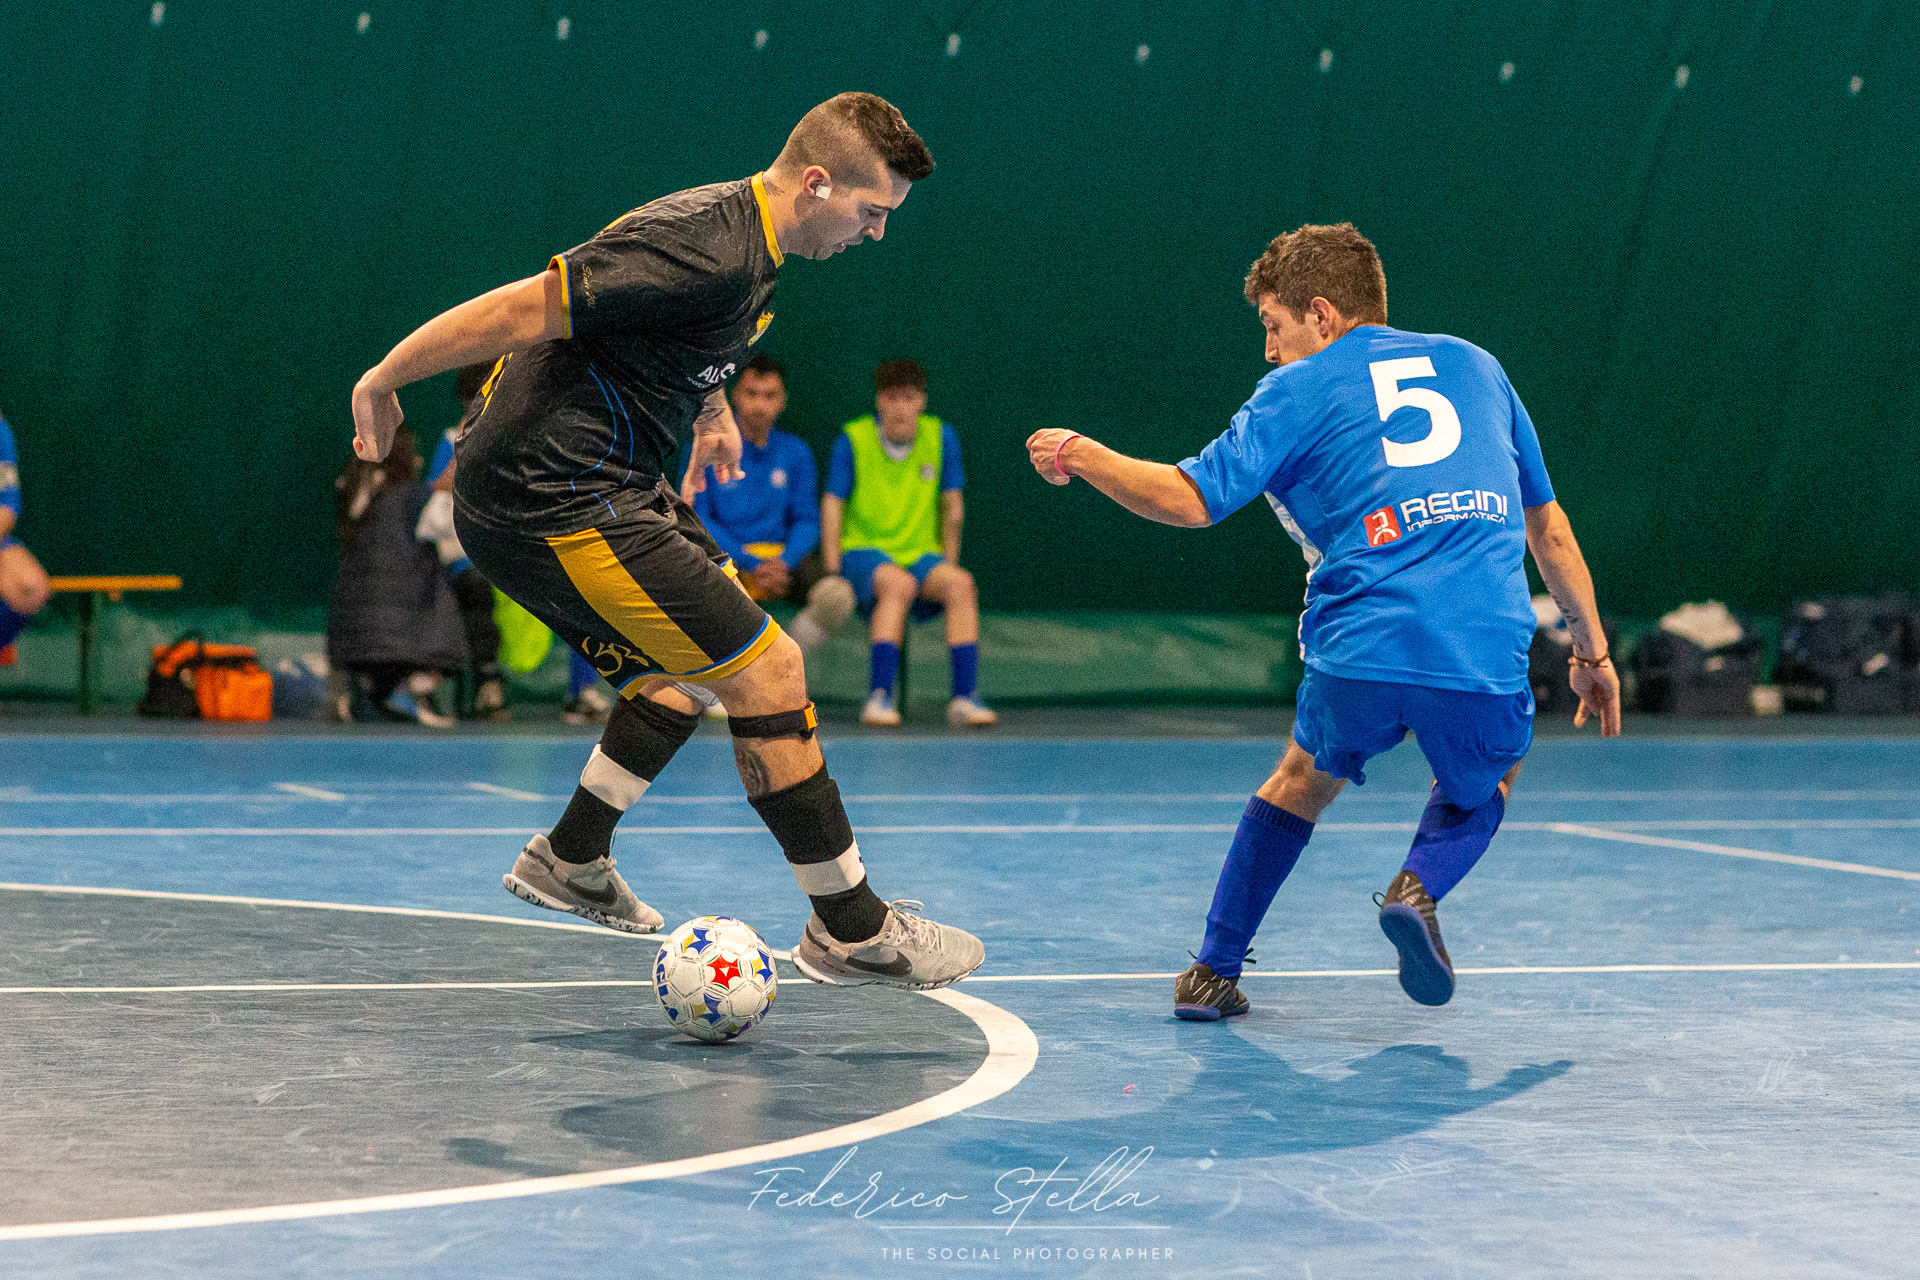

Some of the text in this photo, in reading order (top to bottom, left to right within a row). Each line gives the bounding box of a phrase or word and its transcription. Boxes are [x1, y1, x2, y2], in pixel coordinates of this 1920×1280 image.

[1369, 356, 1462, 468] 5
[1400, 490, 1508, 524] REGINI
[1407, 511, 1506, 532] INFORMATICA
